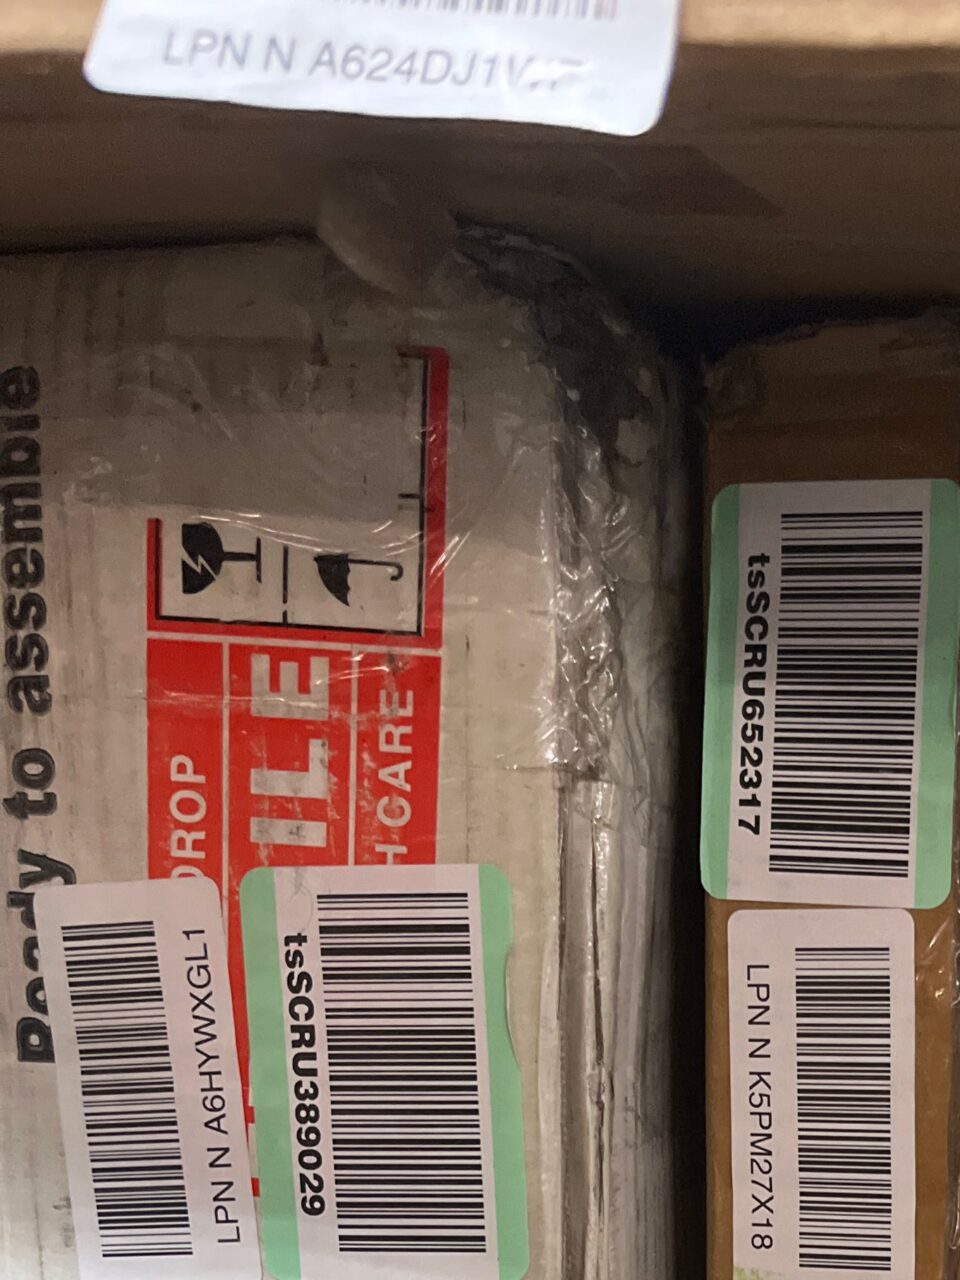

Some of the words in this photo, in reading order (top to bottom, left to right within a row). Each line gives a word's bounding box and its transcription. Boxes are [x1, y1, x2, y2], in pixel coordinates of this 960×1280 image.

[163, 29, 250, 67] LPN
[263, 37, 297, 74] N
[738, 552, 770, 836] tsSCRU652317
[4, 745, 58, 820] to
[250, 653, 329, 848] ILE
[377, 688, 414, 828] CARE
[182, 929, 229, 1136] A6HYWXGL1
[746, 964, 770, 1026] LPN
[748, 1037, 771, 1059] N
[283, 932, 326, 1217] tsSCRU389029
[206, 1146, 232, 1169] N
[748, 1070, 774, 1250] K5PM27X18
[210, 1181, 240, 1244] LPN
